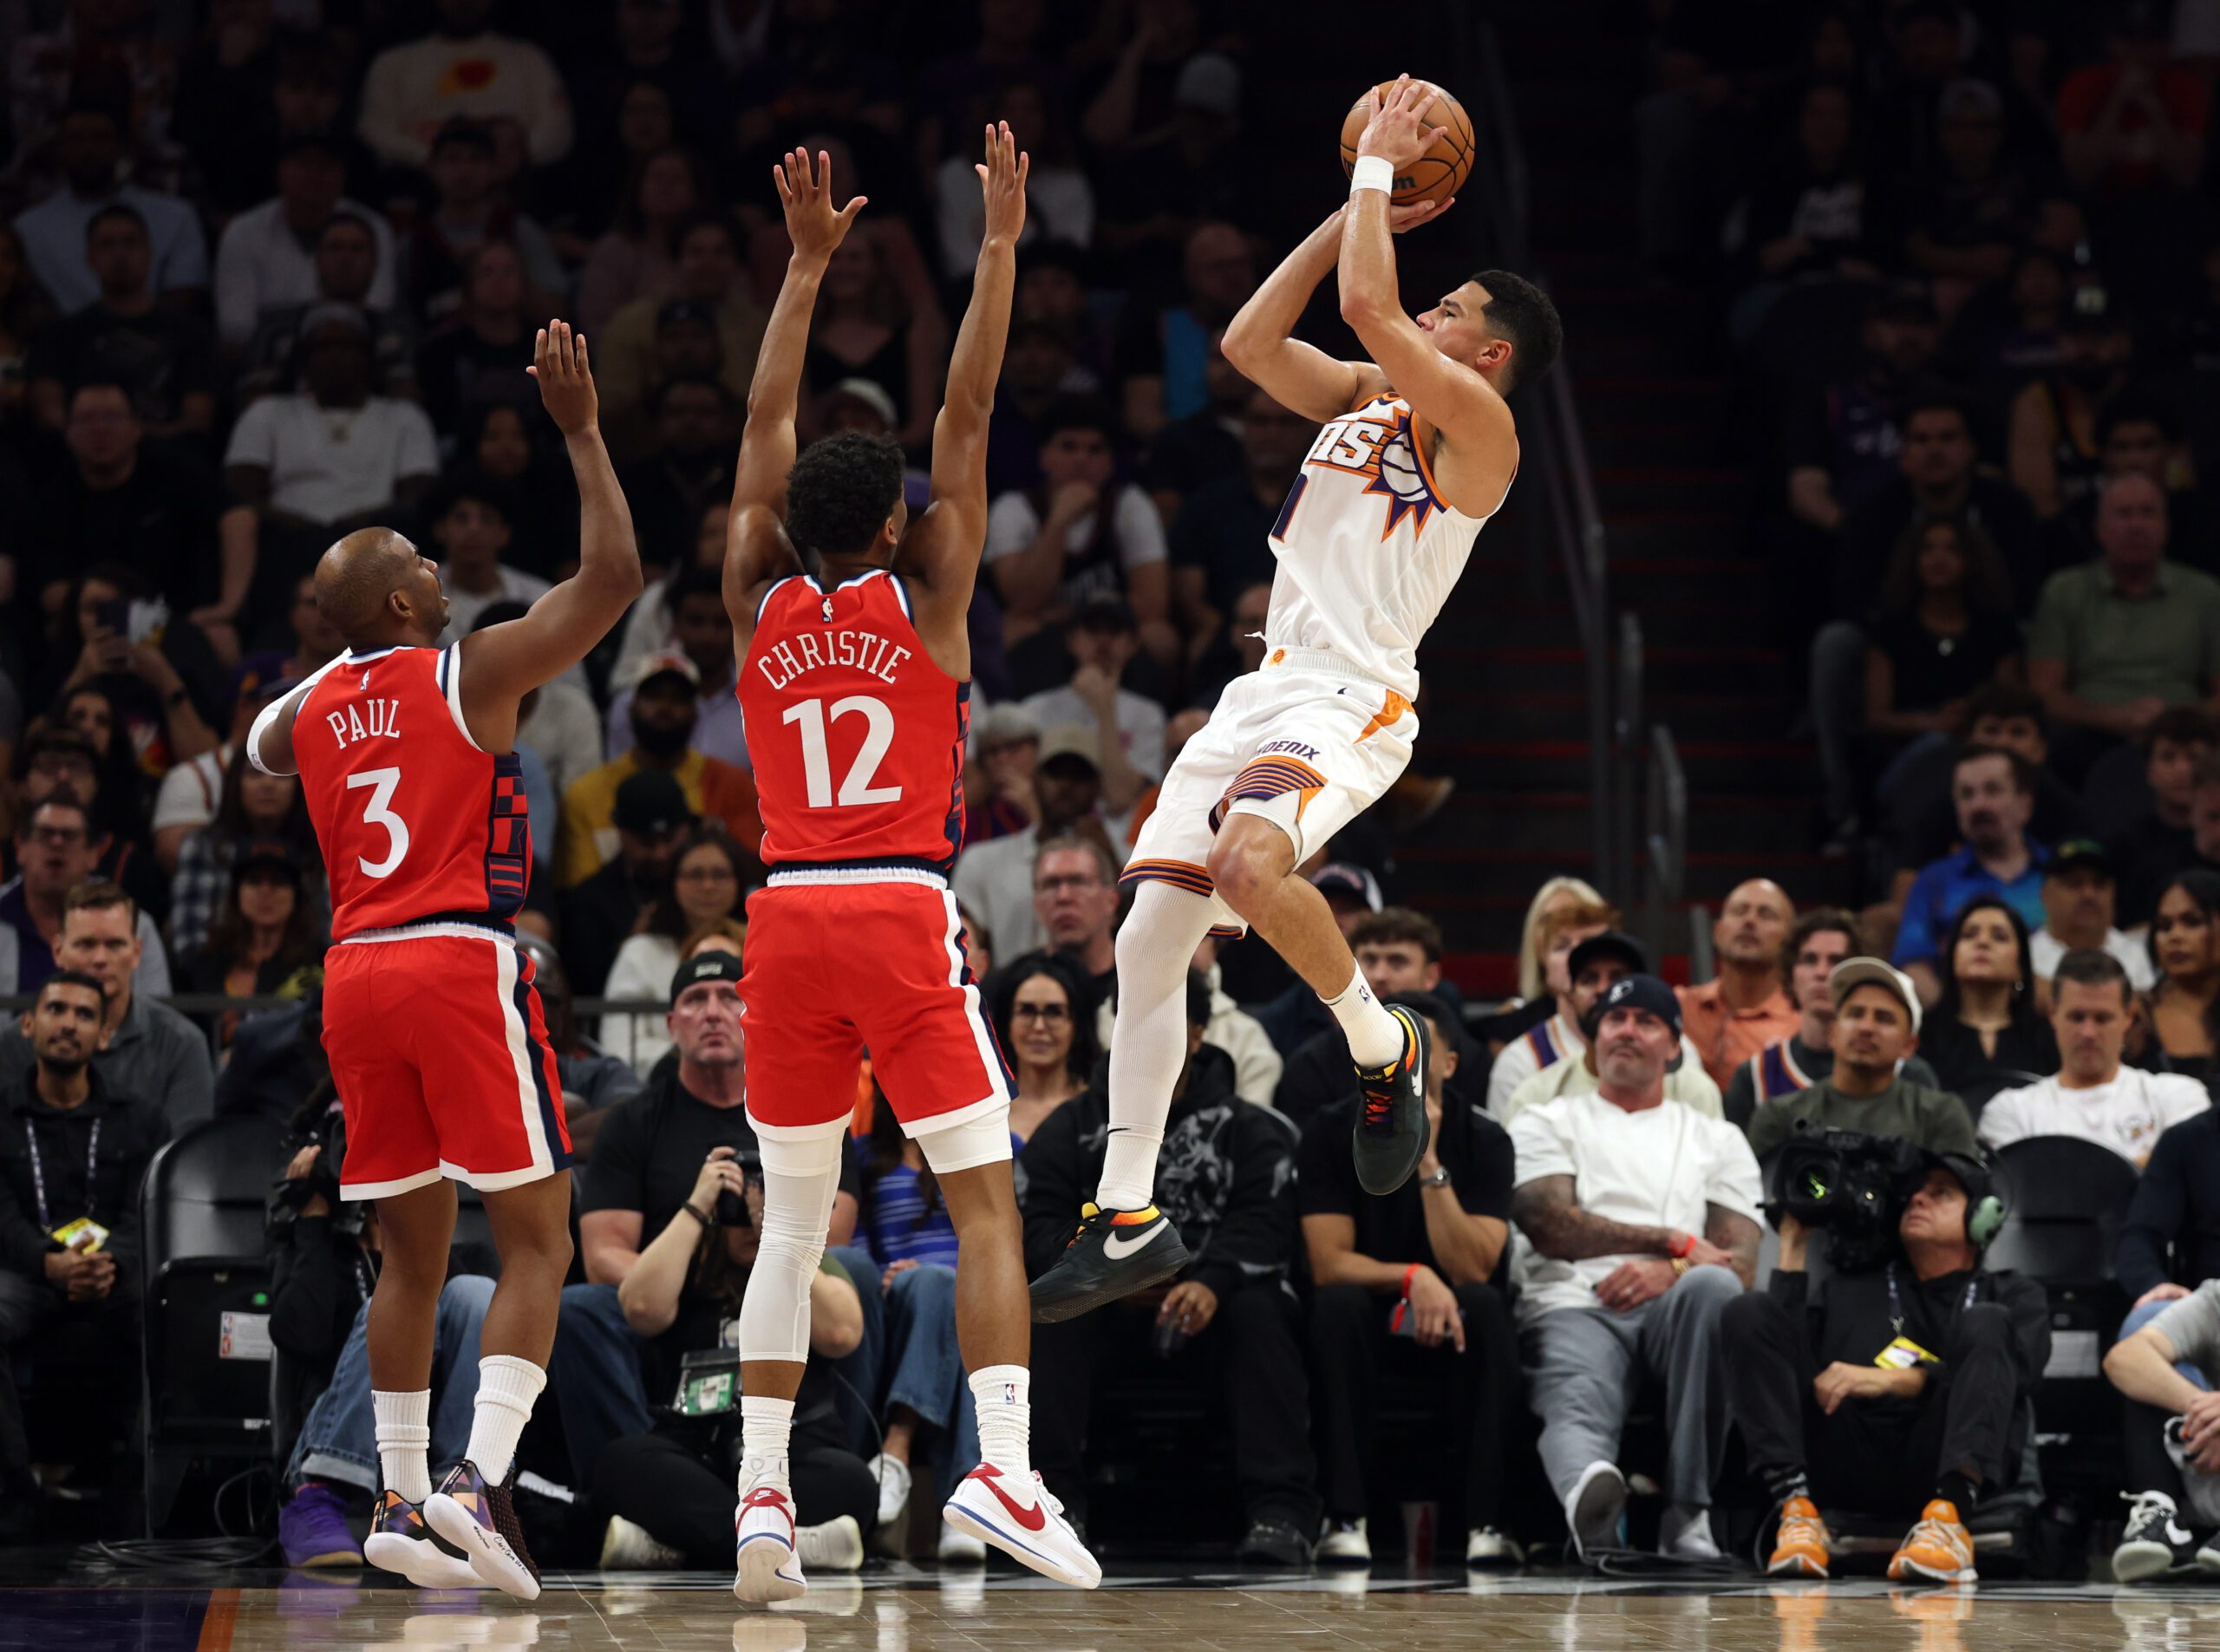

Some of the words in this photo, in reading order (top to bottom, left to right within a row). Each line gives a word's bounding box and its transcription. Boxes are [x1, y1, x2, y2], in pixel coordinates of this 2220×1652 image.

[758, 630, 912, 690] CHRISTIE
[326, 698, 401, 749] PAUL
[782, 695, 903, 808] 12
[347, 767, 409, 878] 3
